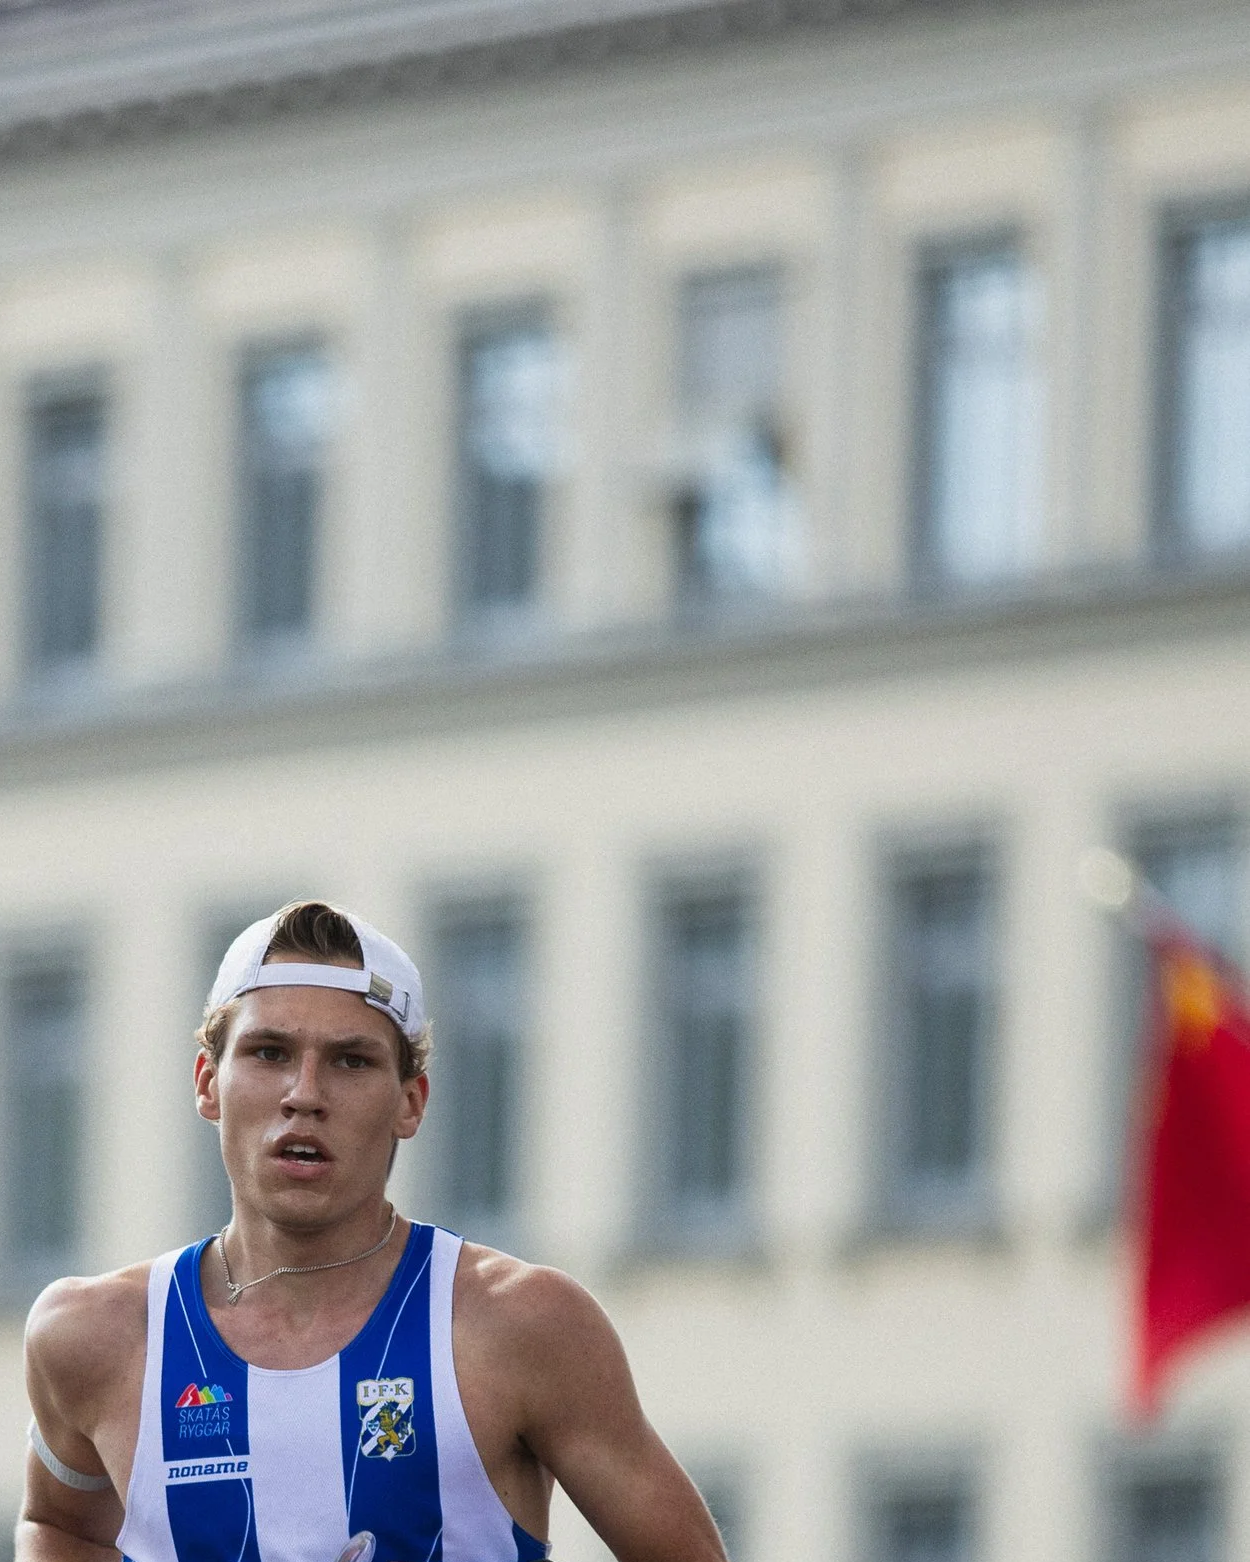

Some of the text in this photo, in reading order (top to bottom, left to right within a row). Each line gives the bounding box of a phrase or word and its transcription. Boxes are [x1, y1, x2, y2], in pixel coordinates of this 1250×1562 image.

[179, 1404, 230, 1424] SKATÅS
[179, 1421, 230, 1439] RYGGAR
[168, 1461, 248, 1479] noname
